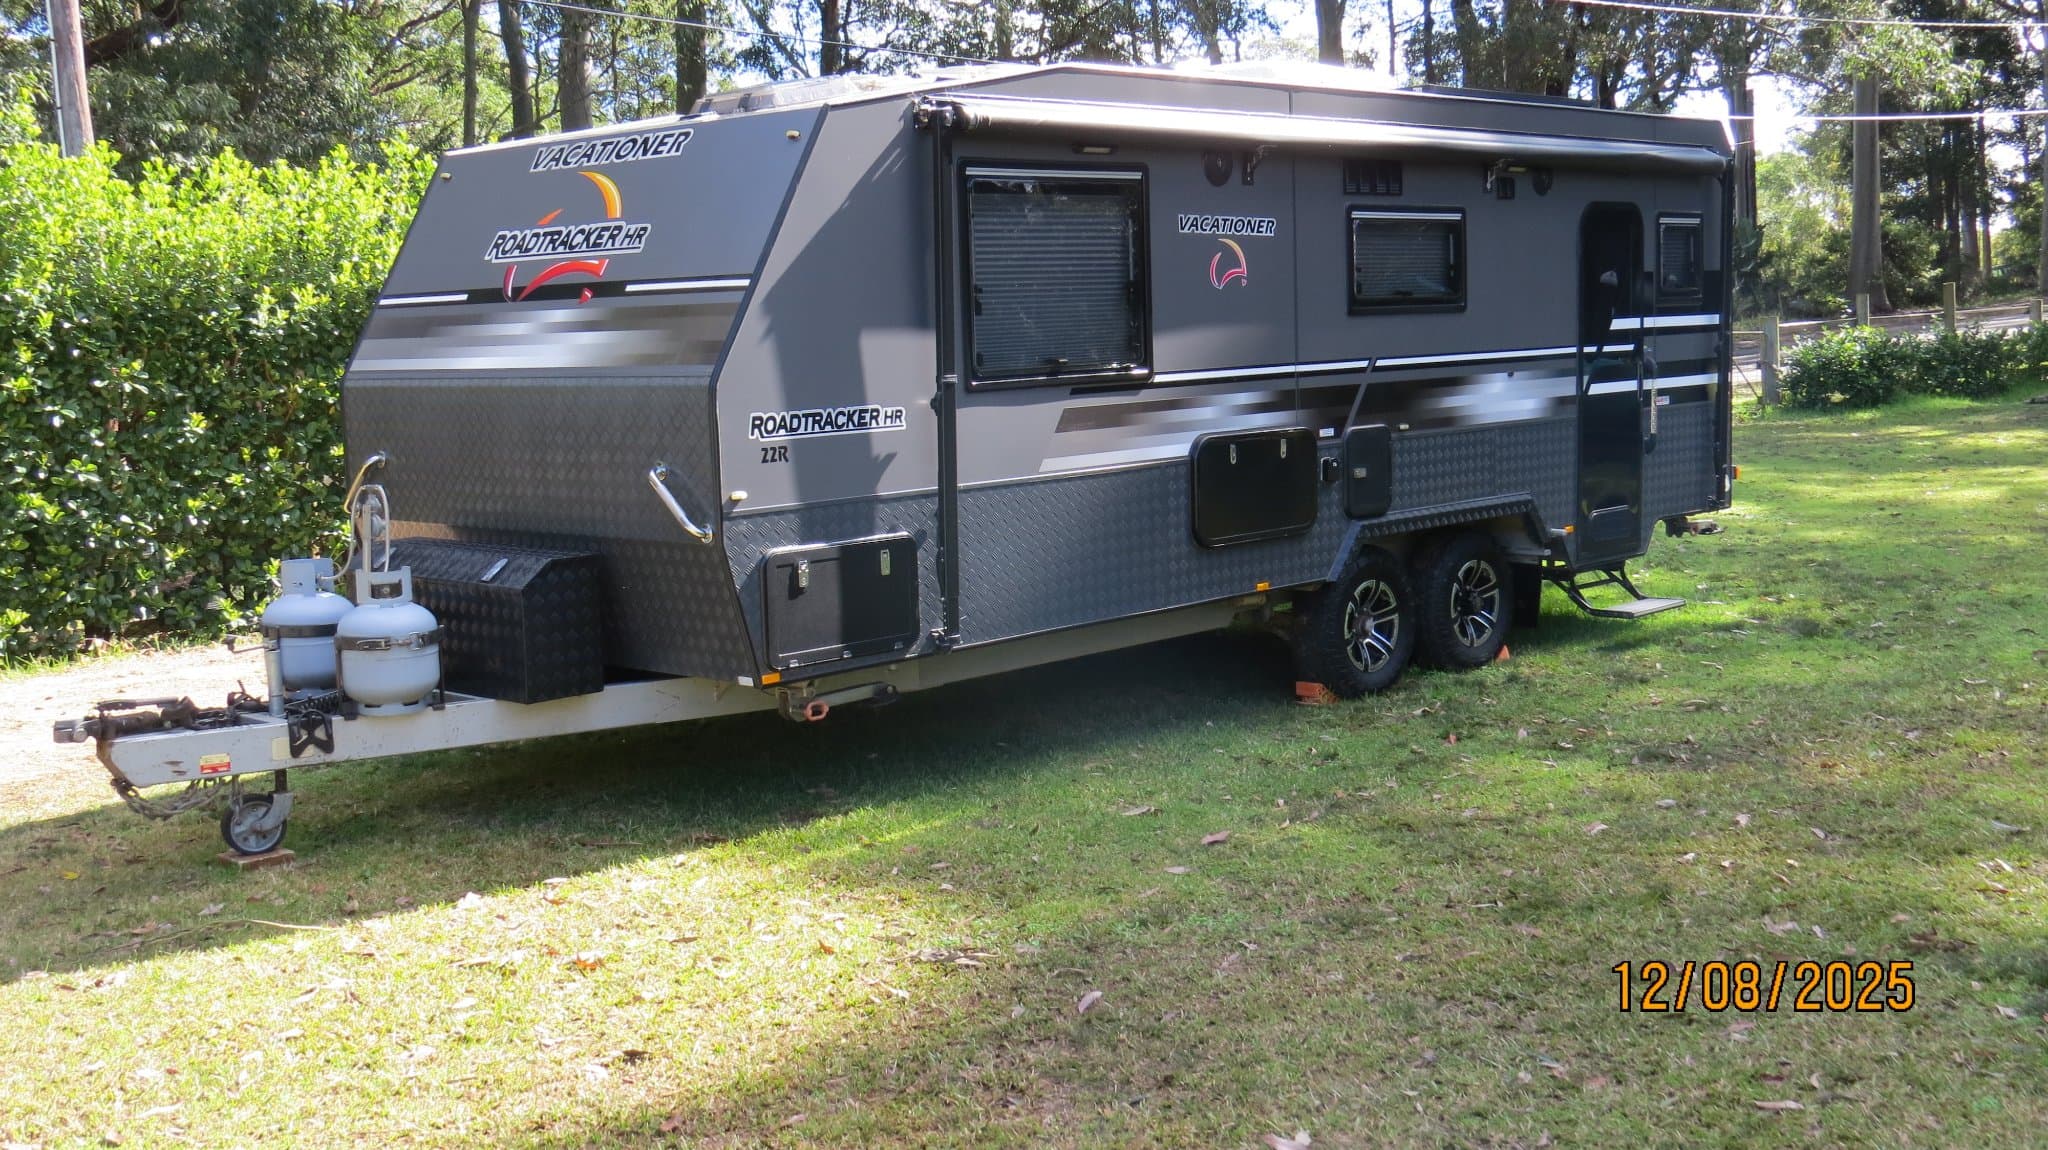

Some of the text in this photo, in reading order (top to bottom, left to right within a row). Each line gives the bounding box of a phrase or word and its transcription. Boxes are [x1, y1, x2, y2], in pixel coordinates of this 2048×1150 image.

[531, 130, 693, 171] VACATIONER
[1179, 215, 1275, 235] VACATIONER
[486, 223, 649, 259] ROADTRACKER HR
[750, 407, 904, 438] ROADTRACKER HR
[760, 445, 789, 464] 22R
